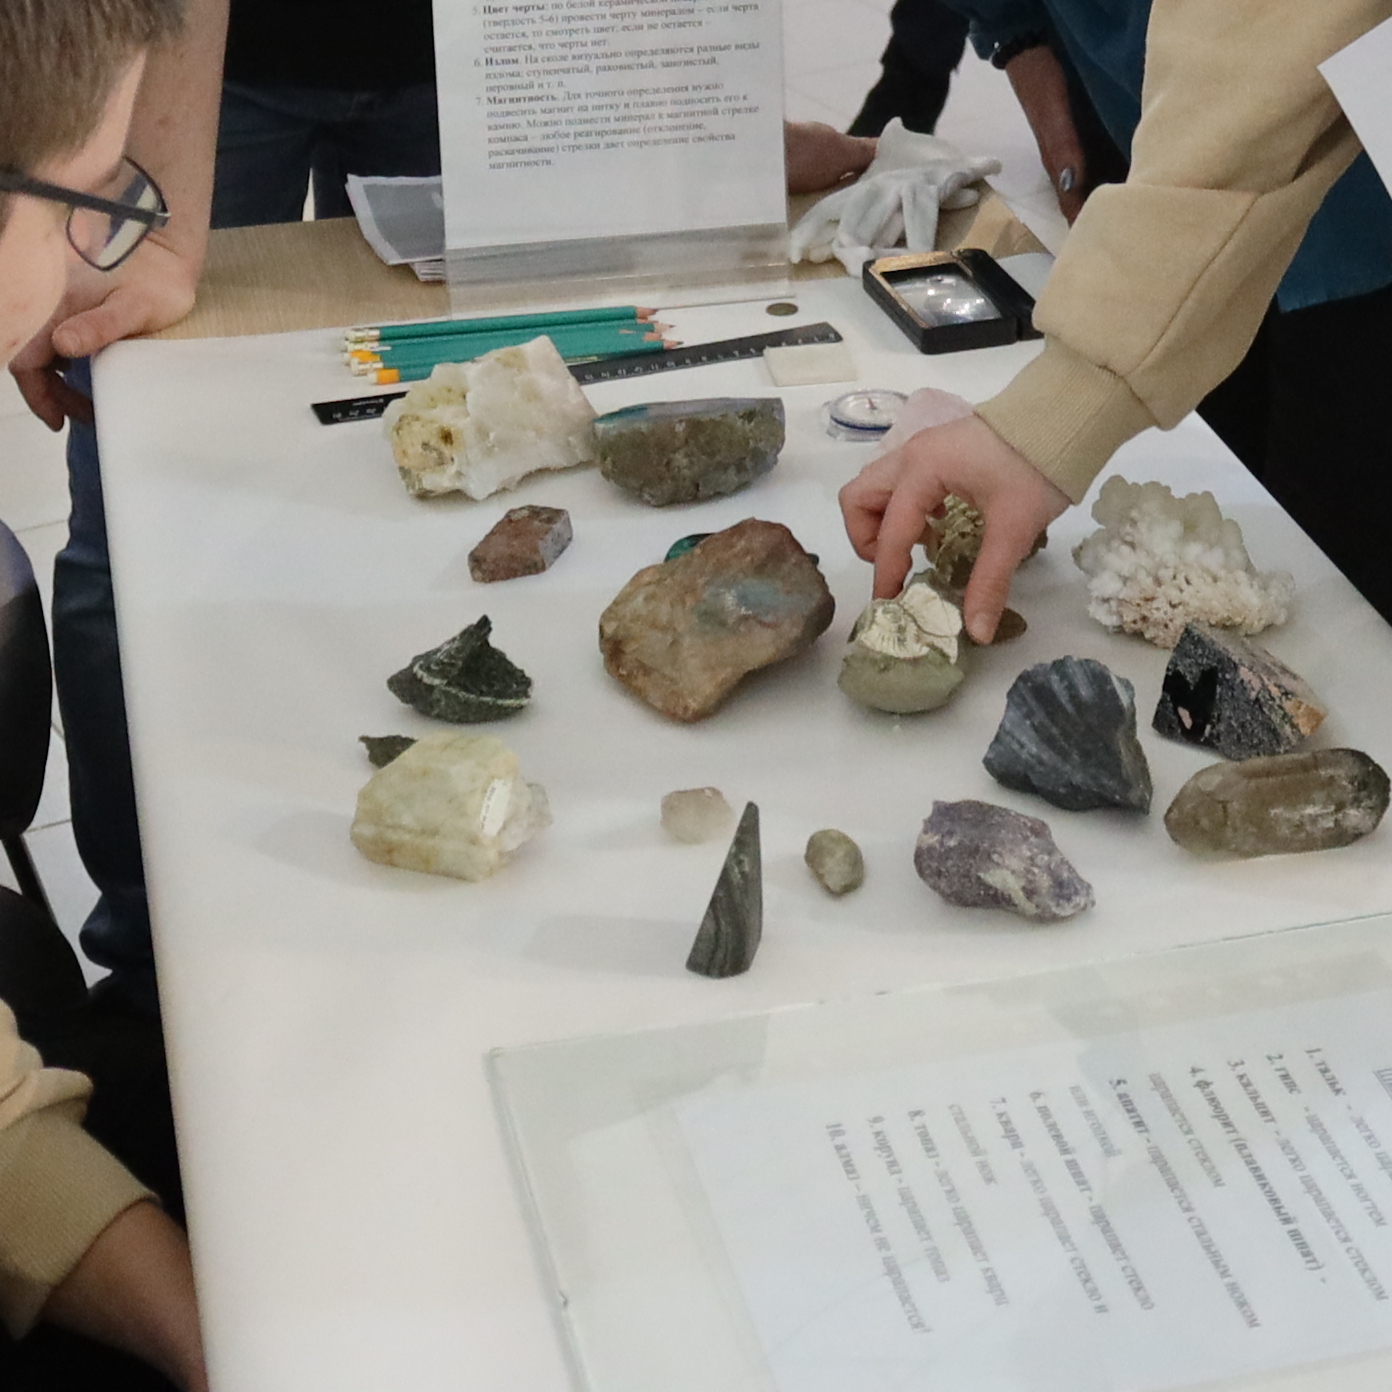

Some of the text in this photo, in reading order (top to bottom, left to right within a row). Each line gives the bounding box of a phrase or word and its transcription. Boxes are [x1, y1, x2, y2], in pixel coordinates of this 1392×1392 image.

[944, 1103, 989, 1157] стальной
[989, 1110, 1027, 1150] кварц
[1079, 1108, 1123, 1157] иголкой
[1143, 1072, 1229, 1187] царапается стеклом
[1312, 1060, 1349, 1096] тальк
[1350, 1115, 1385, 1149] легко
[910, 1124, 942, 1159] топаз
[1273, 1066, 1304, 1094] гипс
[1299, 1113, 1361, 1181] царапается
[1348, 1182, 1390, 1226] ногтем
[933, 1169, 964, 1203] легко
[1018, 1160, 1050, 1194] легко
[1190, 1079, 1241, 1134] флюорит
[1226, 1136, 1300, 1226] (плавиковый
[1282, 1227, 1328, 1271] шпат)
[1230, 1072, 1279, 1124] кальцит
[1275, 1138, 1309, 1172] легко
[1294, 1173, 1355, 1244] царапается
[1343, 1245, 1392, 1301] стеклом
[866, 1129, 905, 1176] корунд
[892, 1185, 936, 1242] царапает
[922, 1245, 954, 1282] топаз
[947, 1205, 993, 1263] царапает
[1033, 1104, 1078, 1156] полевой
[1061, 1158, 1094, 1192] шпат
[1083, 1204, 1131, 1262] царапает
[1118, 1264, 1158, 1310] стекло
[1033, 1196, 1081, 1253] царапает
[1114, 1091, 1152, 1134] апатит
[1142, 1144, 1198, 1213] царапается
[1185, 1215, 1236, 1279] стальным
[1223, 1280, 1264, 1328] ножом
[831, 1142, 863, 1181] алмаз
[853, 1193, 886, 1234] ничем
[877, 1254, 934, 1334] царапается!
[976, 1265, 1014, 1306] кварц
[1067, 1255, 1106, 1302] стекло
